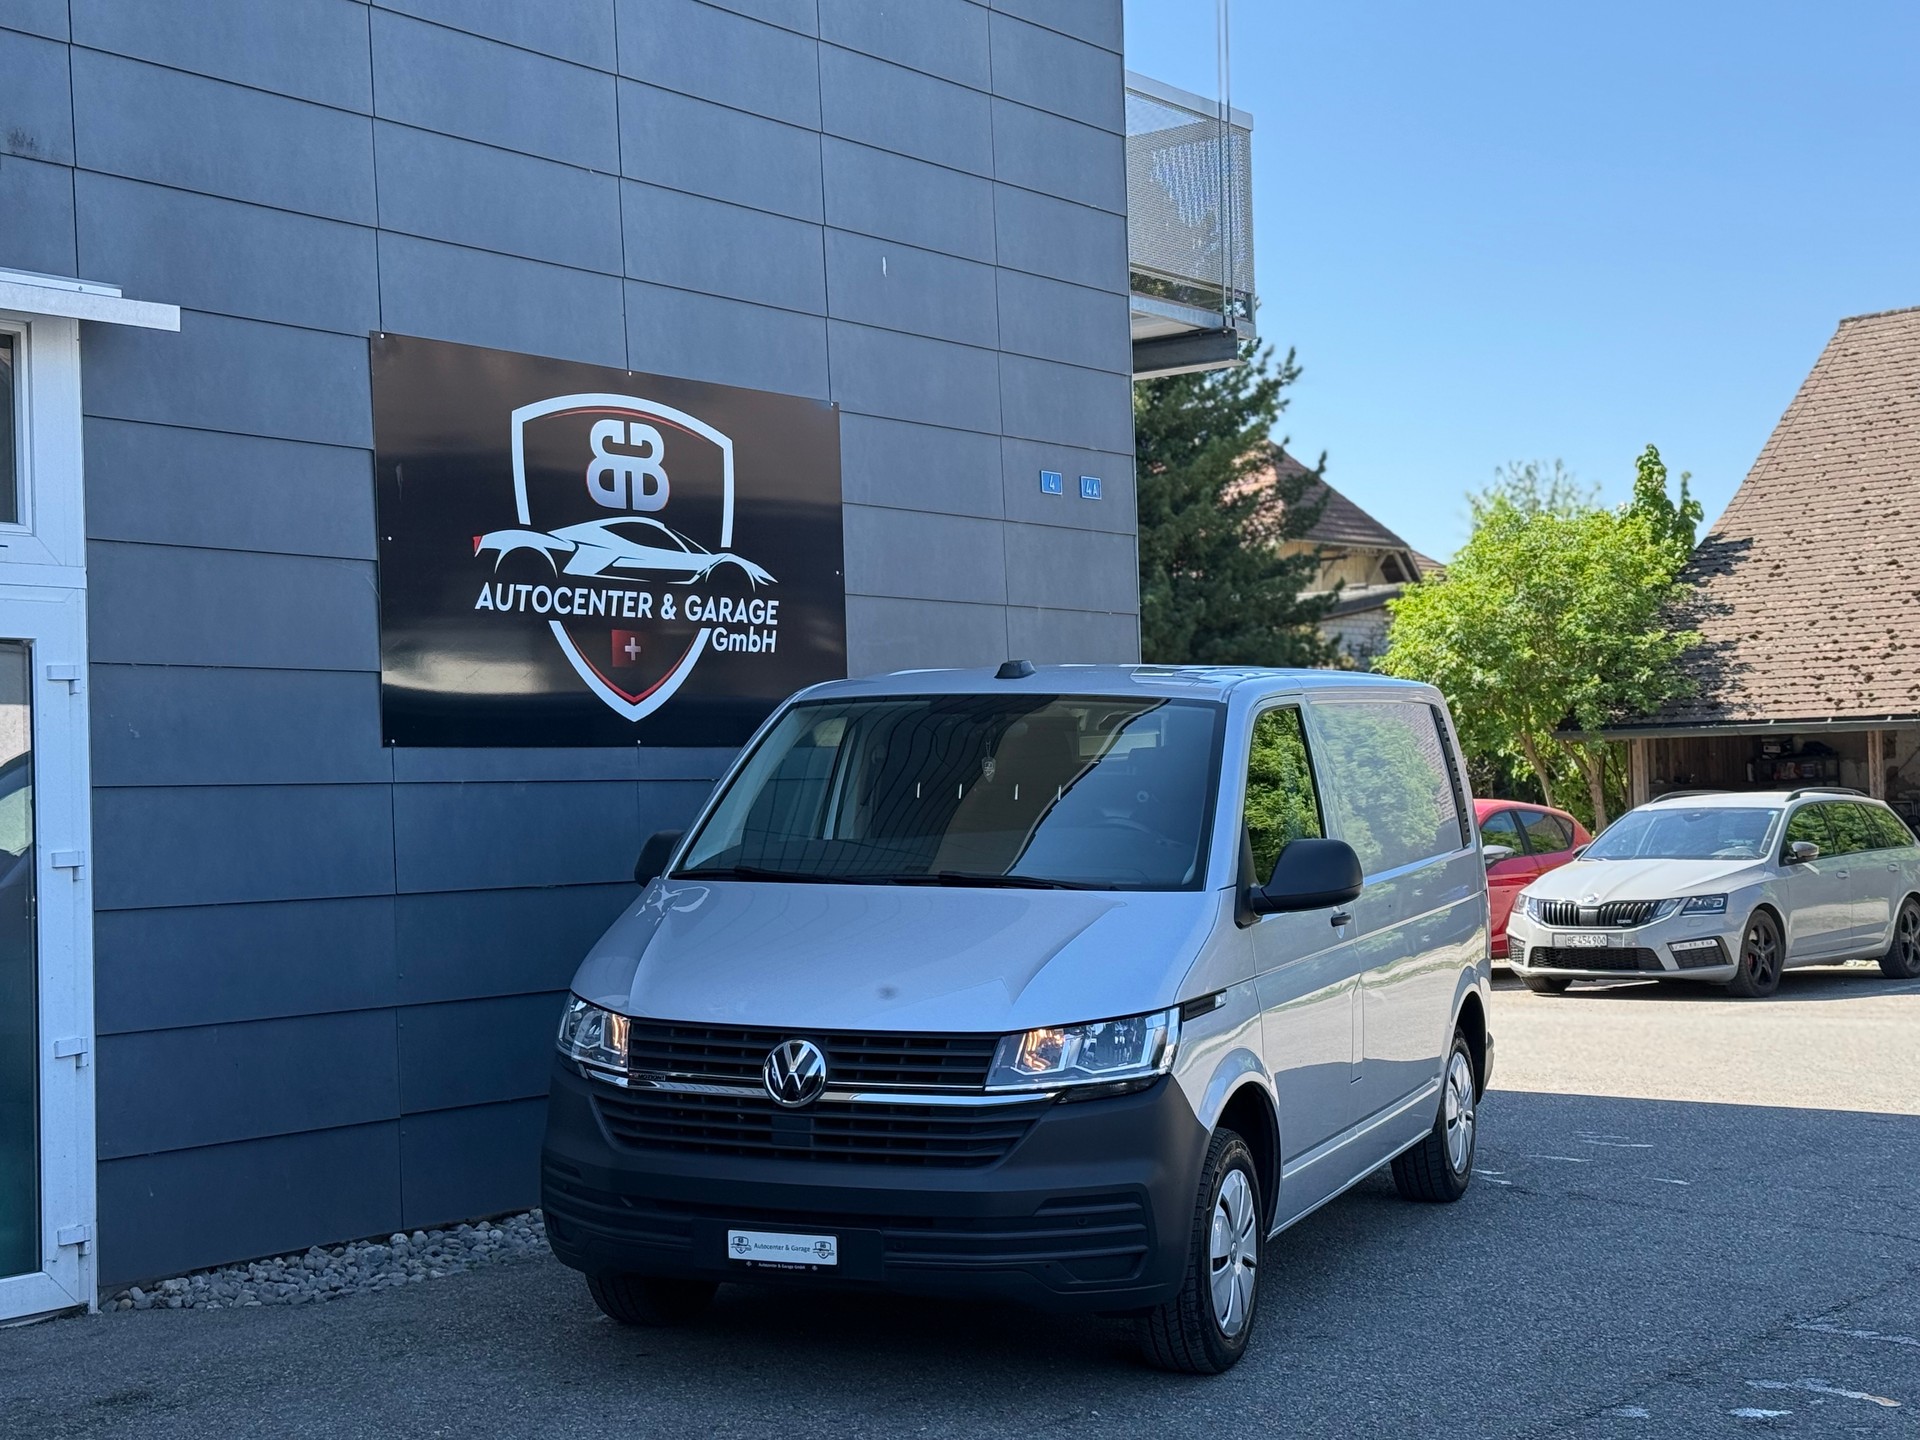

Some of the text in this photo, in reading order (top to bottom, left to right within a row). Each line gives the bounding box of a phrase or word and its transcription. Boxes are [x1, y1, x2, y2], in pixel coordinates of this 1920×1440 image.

[1049, 474, 1055, 490] 4
[1085, 480, 1098, 496] 4A
[474, 581, 780, 626] AUTOCENTER & GARAGE
[711, 626, 777, 653] GmbH
[754, 1243, 784, 1251] Autocenter
[791, 1245, 811, 1253] Garage
